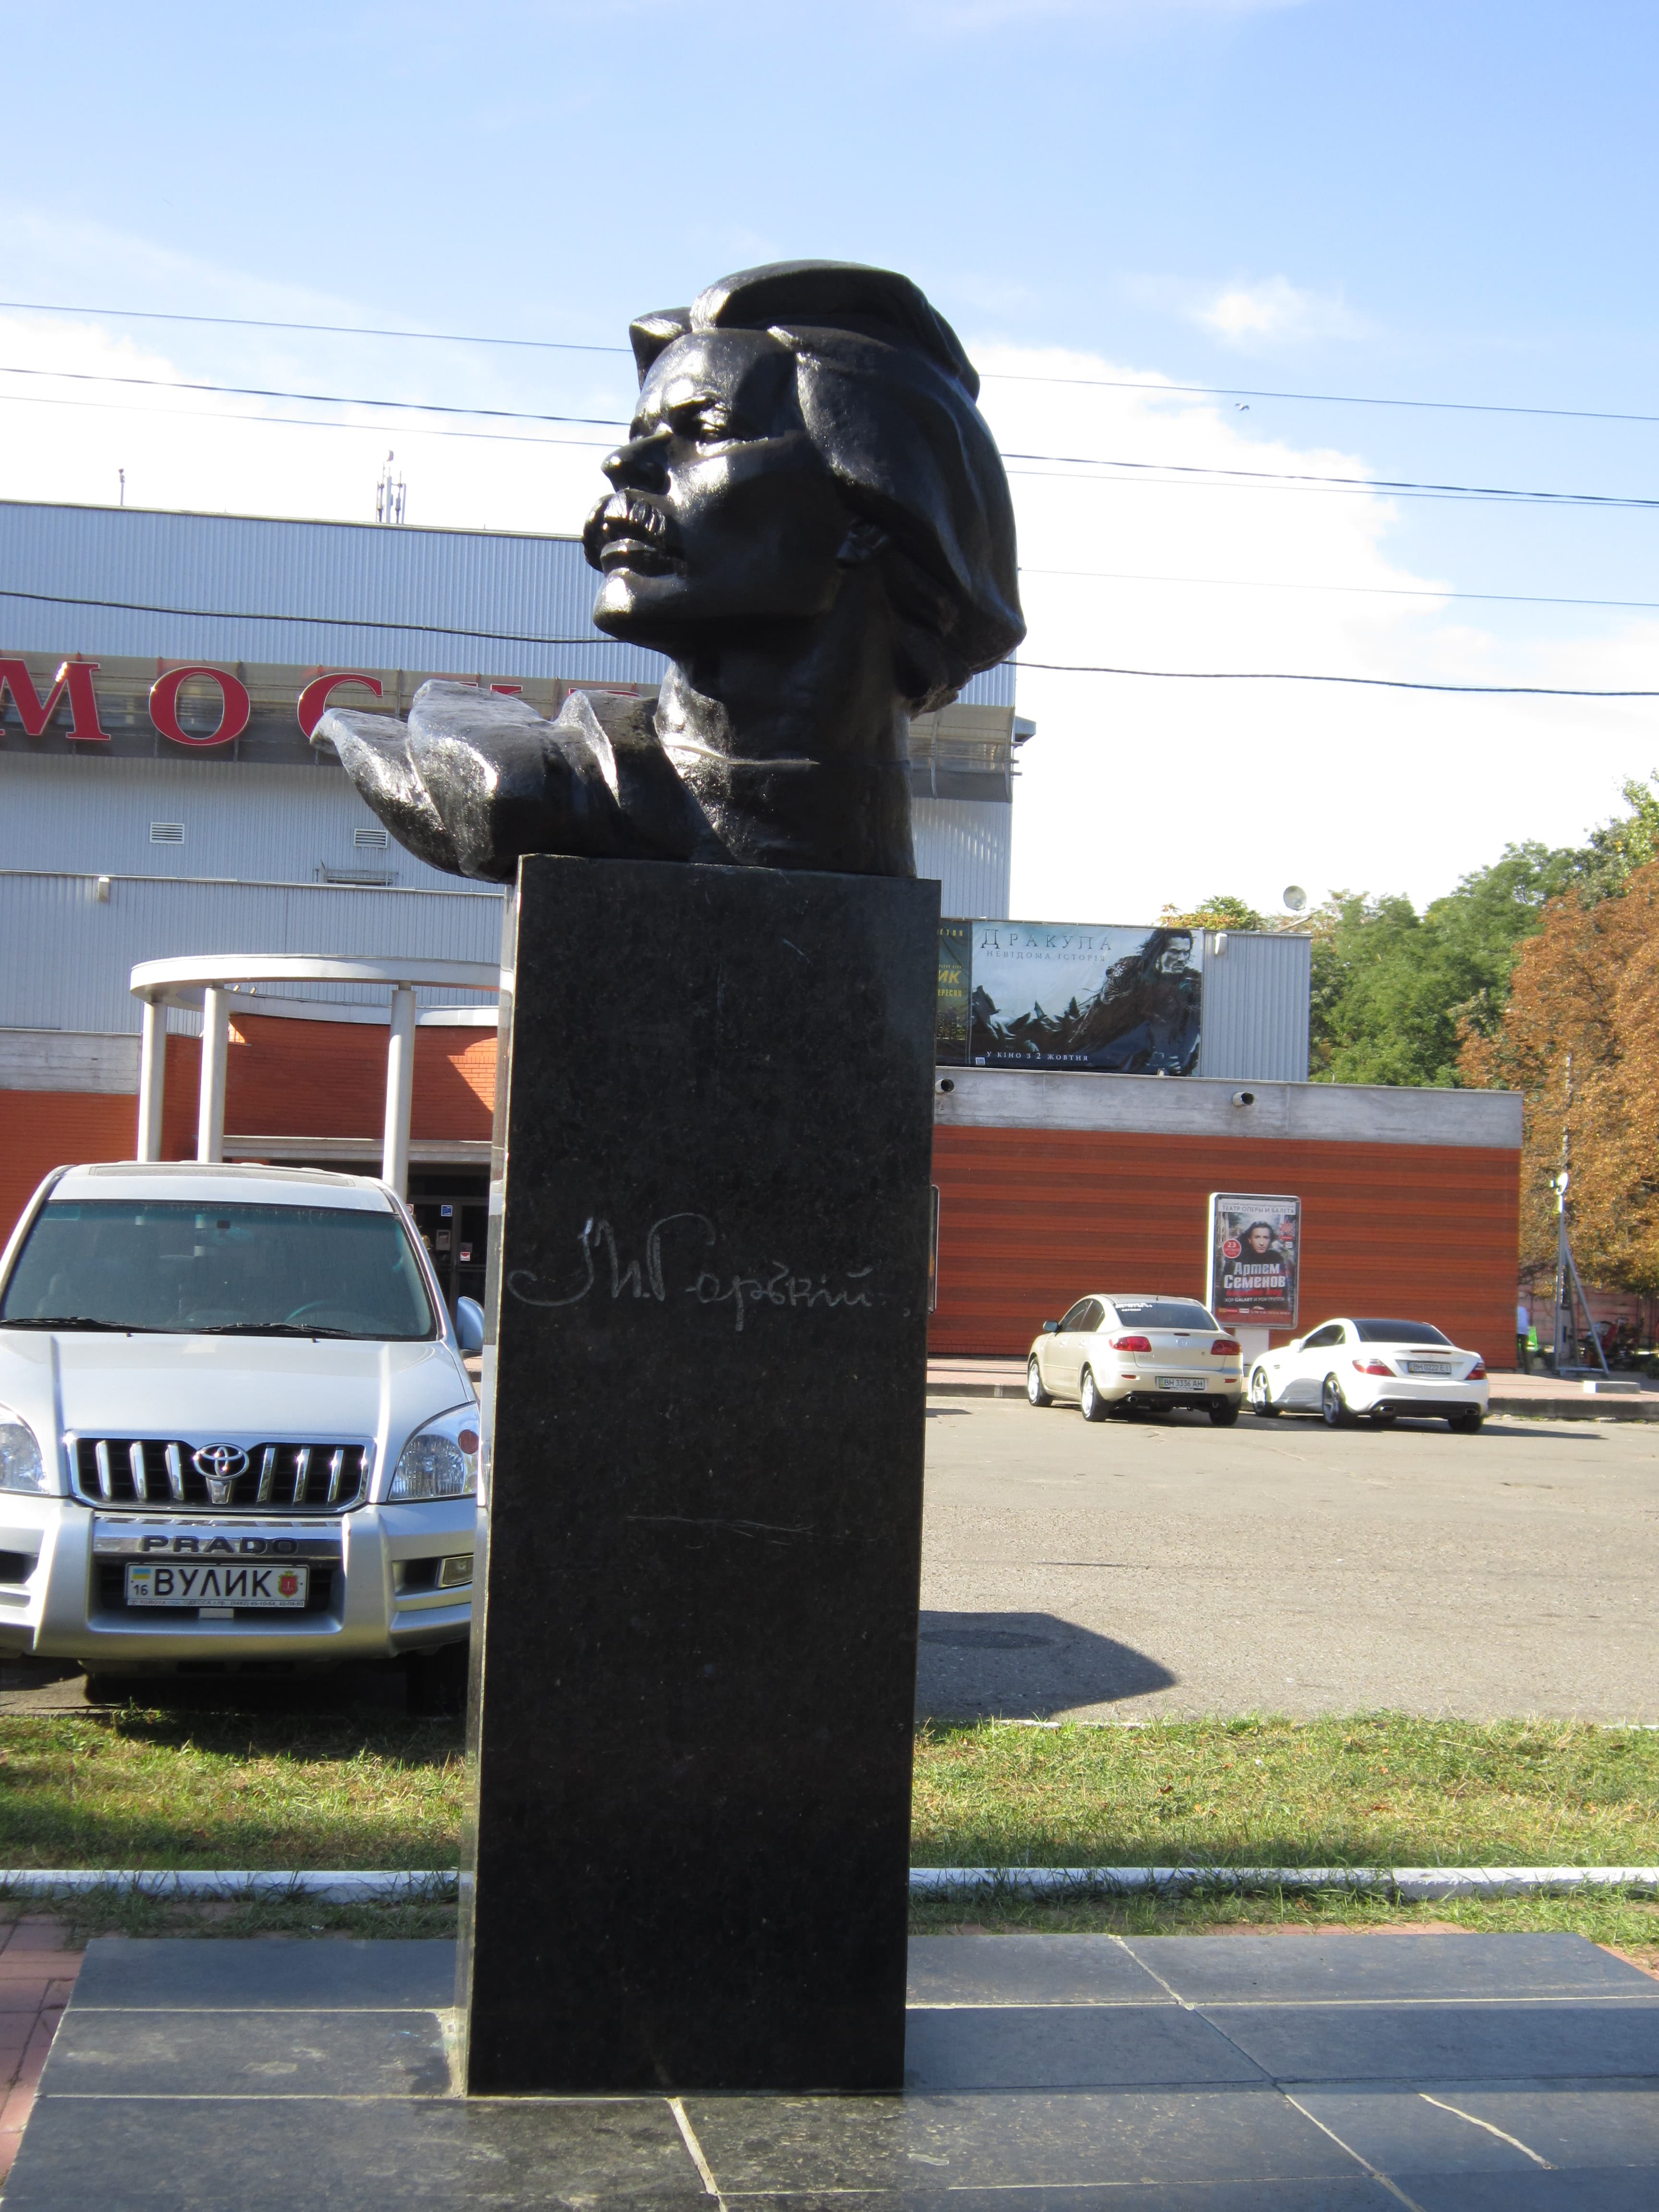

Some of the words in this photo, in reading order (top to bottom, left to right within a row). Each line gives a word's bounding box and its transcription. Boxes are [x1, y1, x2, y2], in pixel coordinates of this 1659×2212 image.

[980, 928, 1112, 950] ДРАКУЛА
[987, 950, 1050, 960] НЕВІДОМА
[1058, 953, 1105, 962] ІСТОРІЯ
[938, 989, 962, 997] ЕРЕСНЯ
[1234, 1262, 1280, 1276] Артем
[1224, 1274, 1286, 1288] Семенов
[140, 1535, 298, 1555] PRADO
[154, 1569, 273, 1597] ВУЛИК
[133, 1585, 148, 1596] 16
